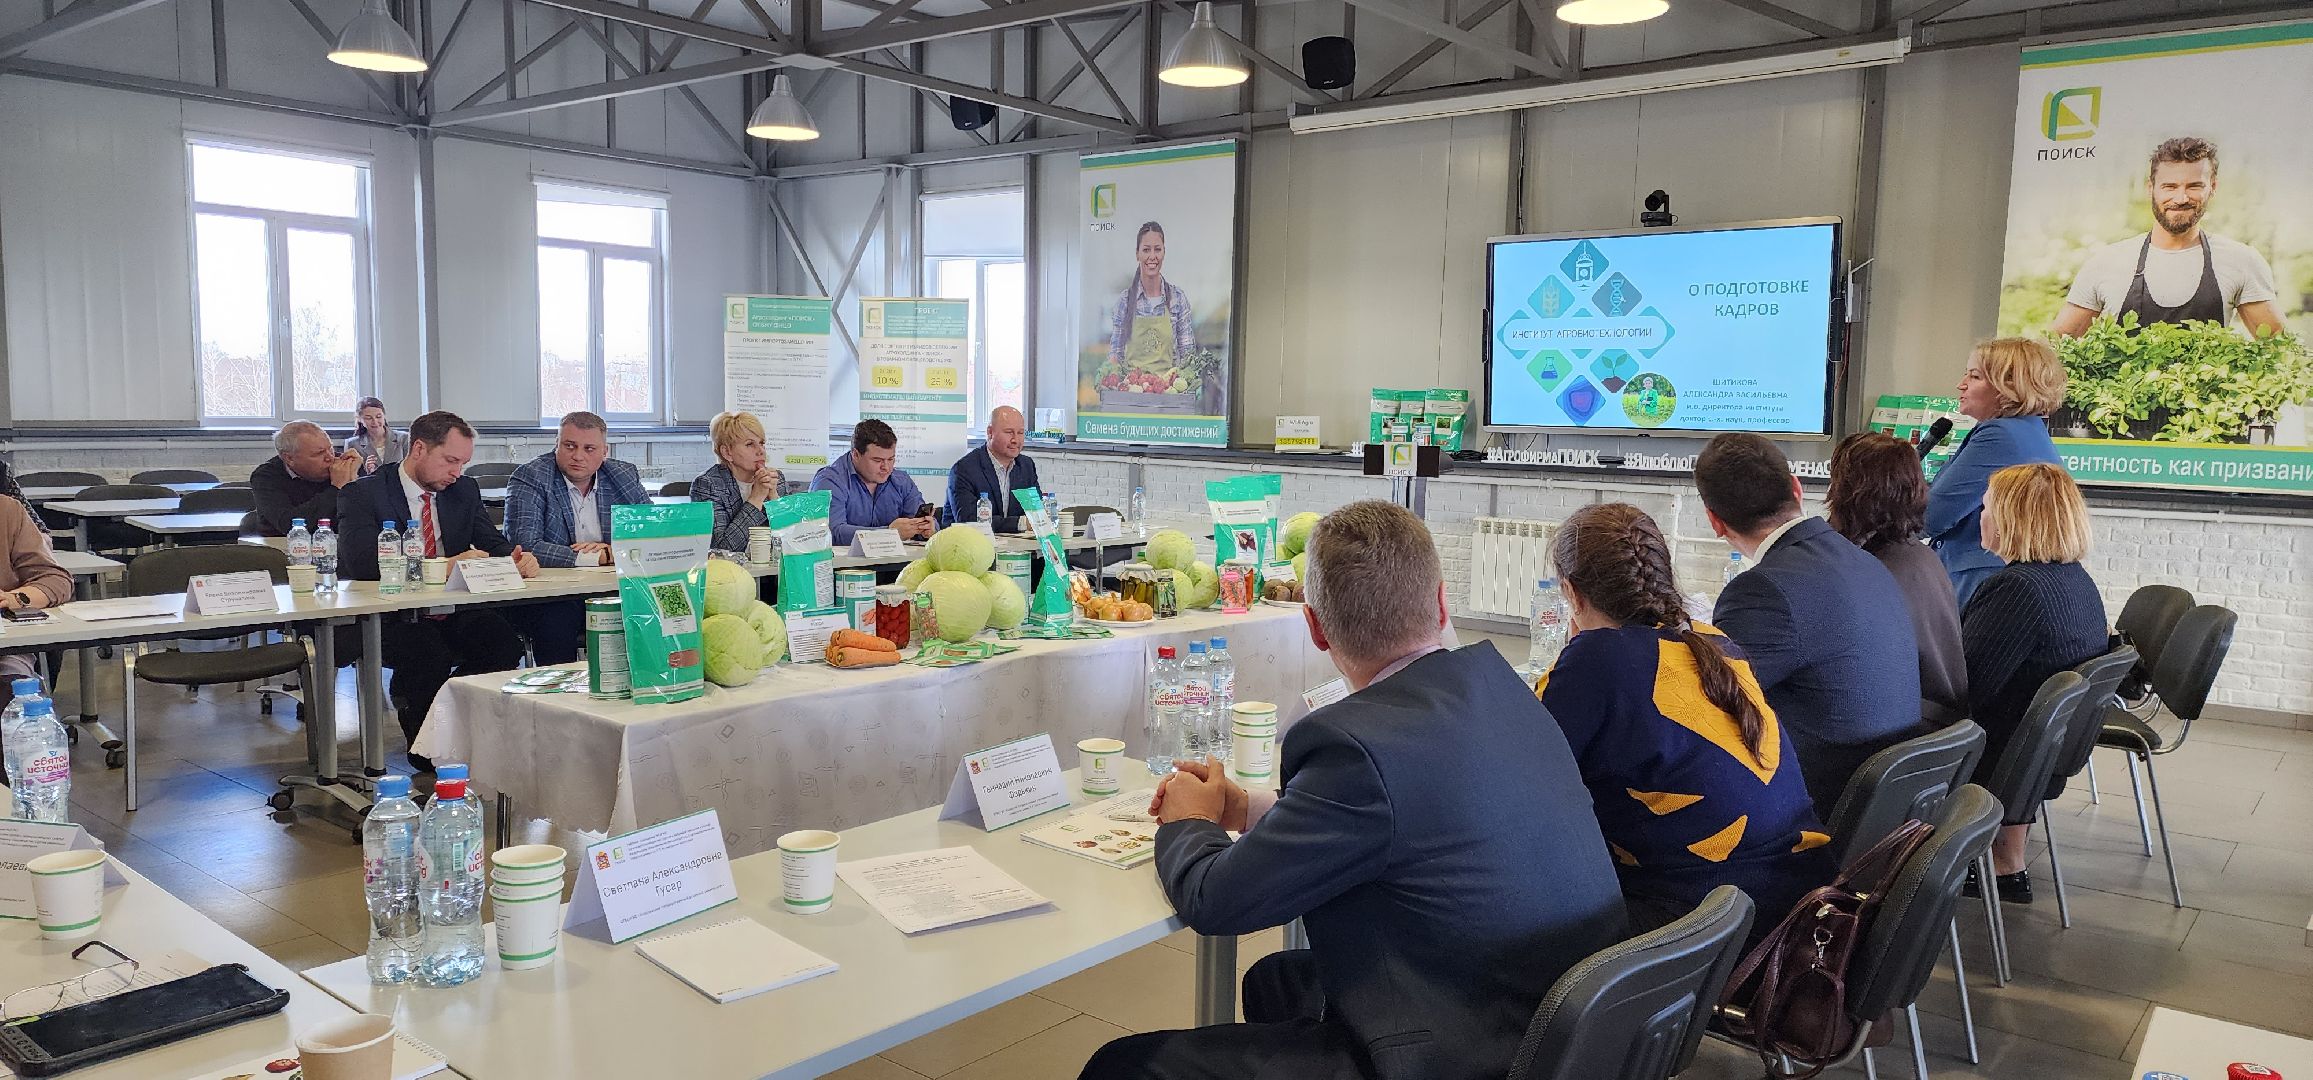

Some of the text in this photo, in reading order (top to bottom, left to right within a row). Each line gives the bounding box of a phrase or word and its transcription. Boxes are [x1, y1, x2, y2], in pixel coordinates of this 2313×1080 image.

[2037, 146, 2096, 161] ПОИСК
[1090, 222, 1117, 231] ПОИСК
[1689, 280, 1809, 297] О ПОДГОТОВКЕ
[1715, 303, 1779, 319] КАДРОВ
[1512, 330, 1553, 339] ИНСТИТУТ
[877, 376, 888, 384] 10
[1085, 420, 1219, 439] Семена будущих достижений
[2061, 454, 2163, 475] тентность
[2168, 460, 2205, 477] как
[27, 762, 68, 773] источни
[602, 851, 723, 898] Светлана Александровна
[655, 879, 683, 897] Гусар
